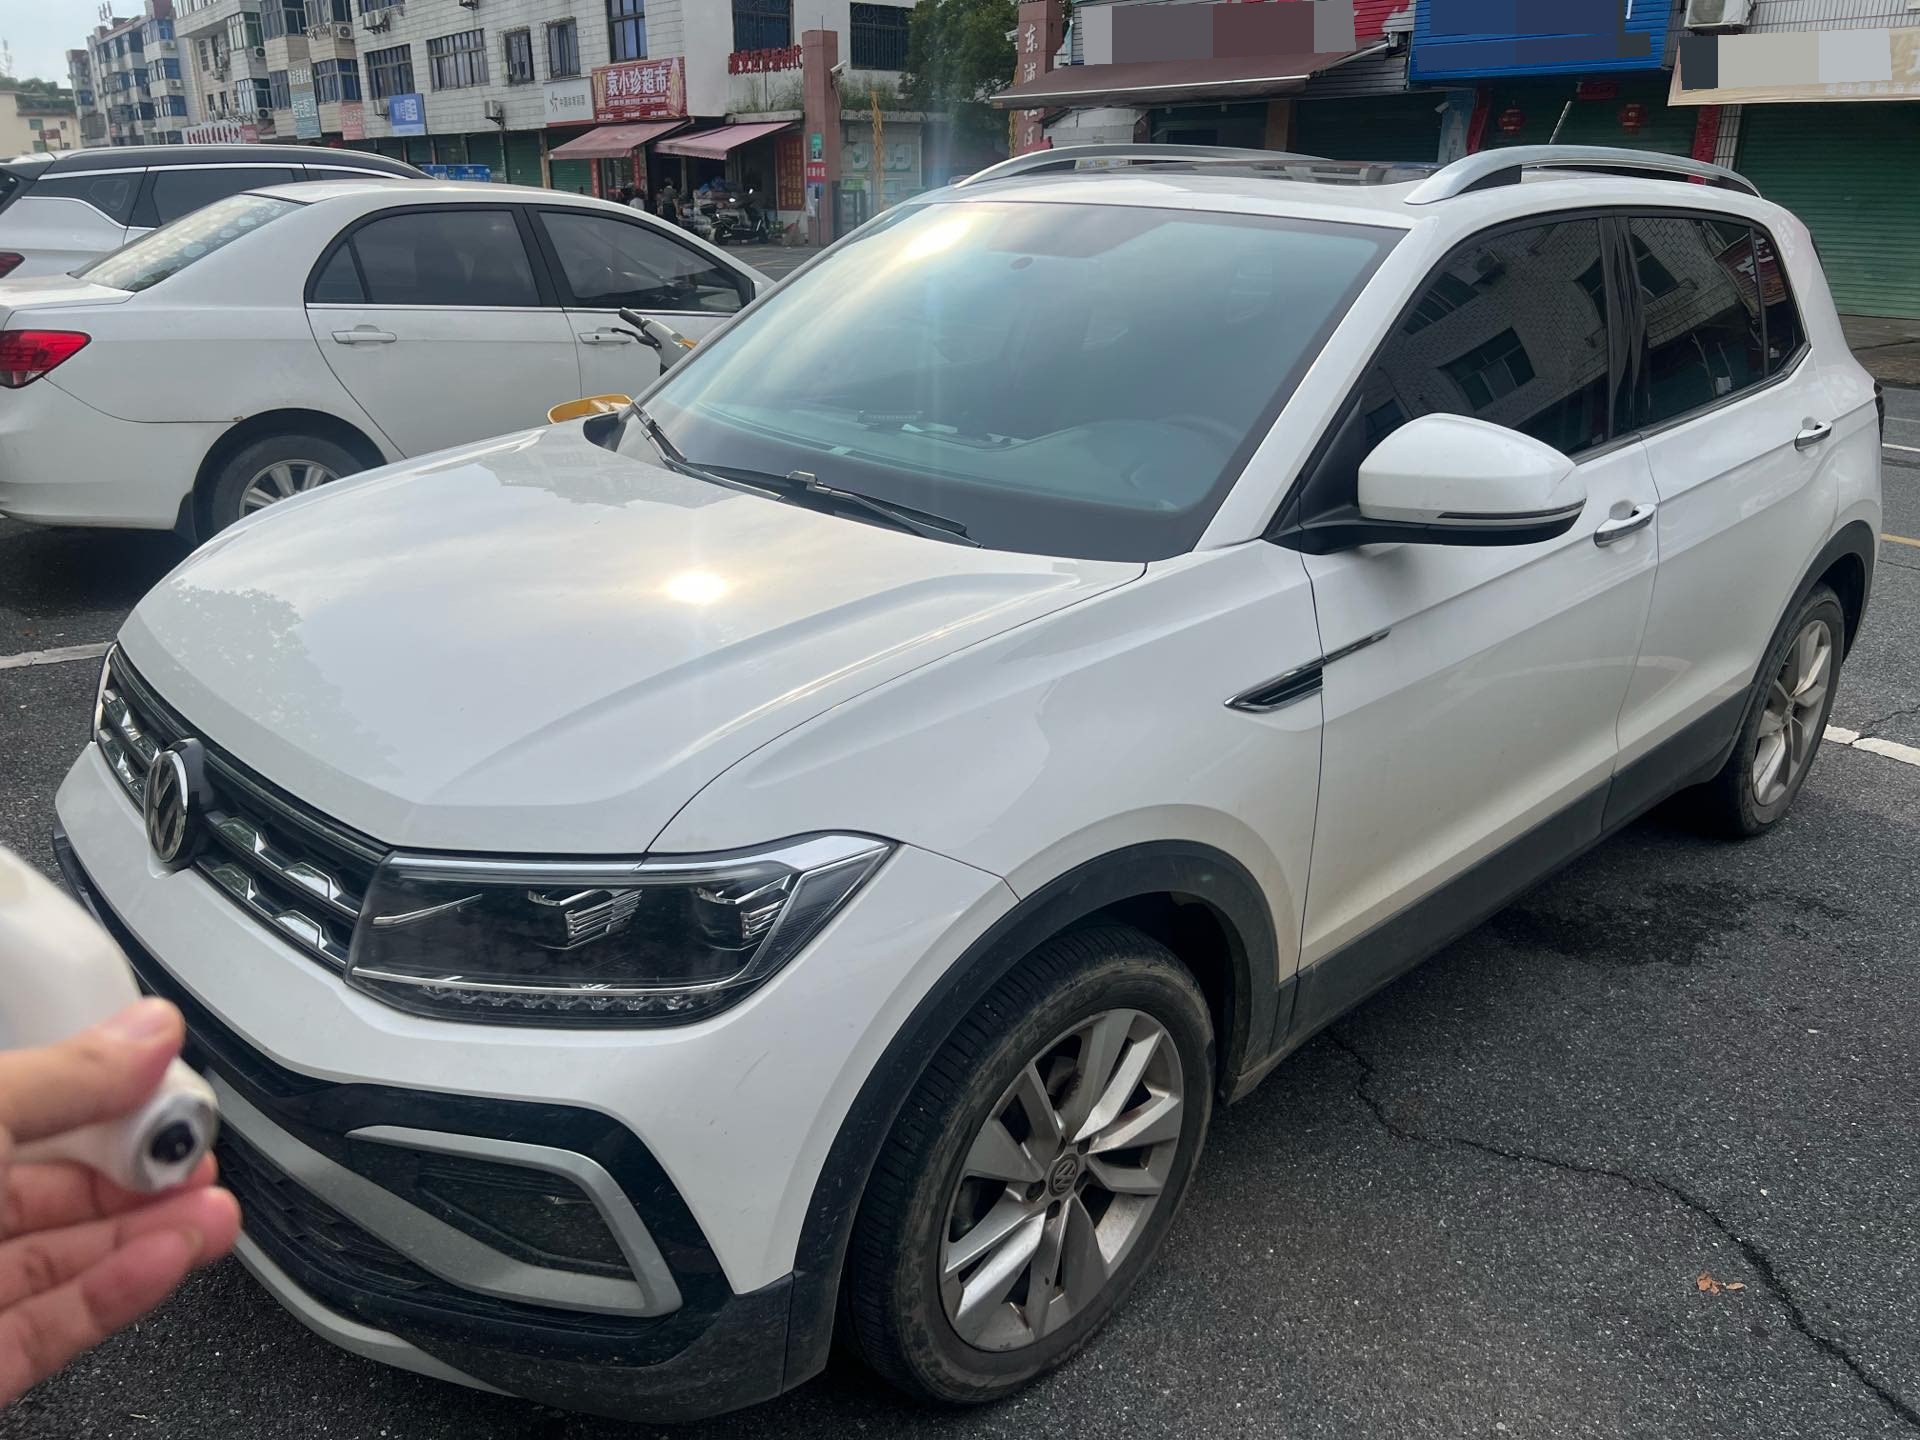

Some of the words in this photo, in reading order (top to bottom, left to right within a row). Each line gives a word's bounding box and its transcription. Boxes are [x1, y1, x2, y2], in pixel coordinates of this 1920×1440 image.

[607, 67, 667, 97] 袁小珍超市
